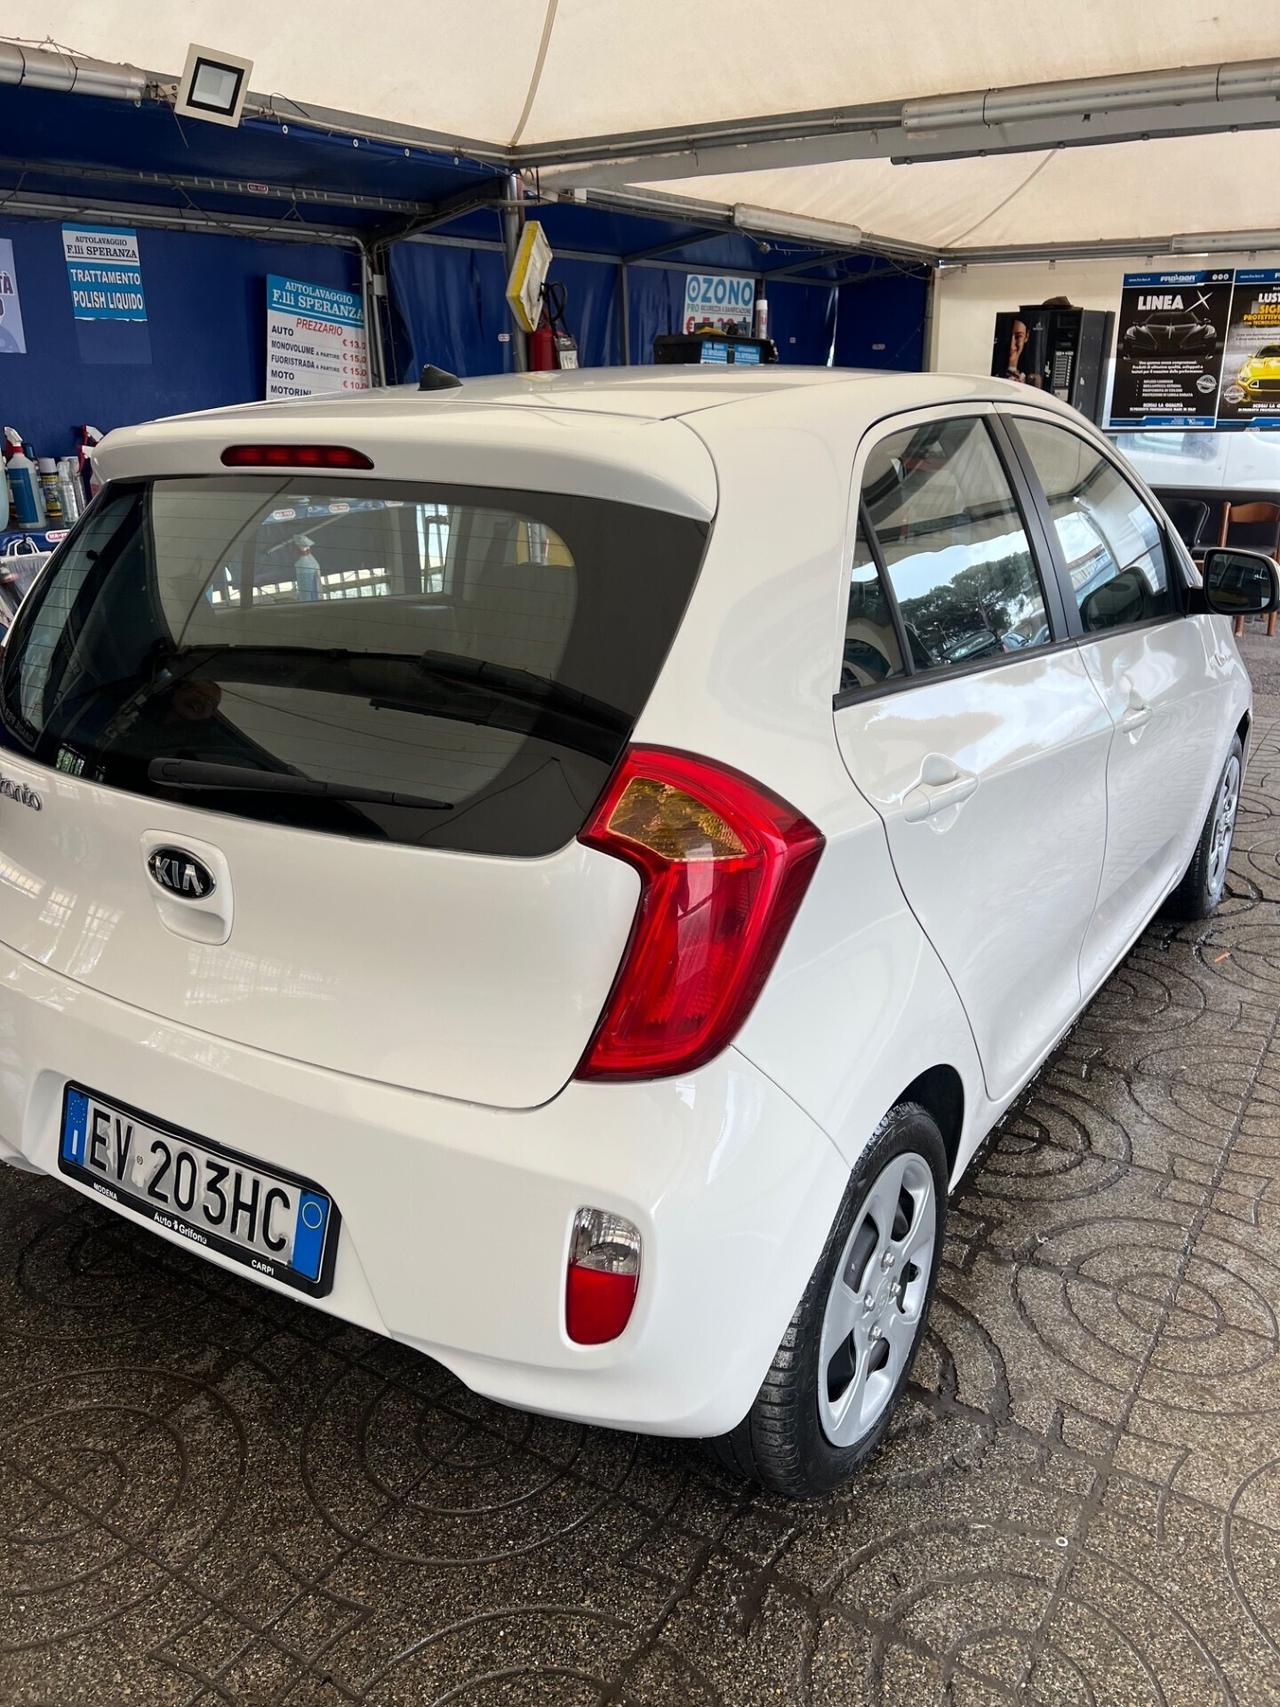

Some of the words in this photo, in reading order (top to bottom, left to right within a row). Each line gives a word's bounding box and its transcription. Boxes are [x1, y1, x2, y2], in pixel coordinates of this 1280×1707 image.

[75, 236, 127, 246] AUTOLAVAGGIO
[66, 244, 84, 255] F.lli
[86, 246, 138, 259] SPERANZA
[70, 269, 140, 285] TRATTAMENTO
[73, 290, 107, 308] POLISH
[107, 291, 144, 310] LIQUIDO
[285, 281, 353, 304] AUTOLAVAGGIO
[687, 276, 753, 306] OZONO
[1137, 294, 1184, 311] LINEA
[1184, 290, 1213, 312] X
[272, 289, 295, 305] F.lli
[298, 295, 365, 320] SPERANZA
[686, 303, 699, 312] PRO
[271, 325, 294, 337] AUTO
[343, 339, 347, 347] €
[296, 318, 343, 336] PREZZARIO
[271, 340, 315, 355] MONOVOLUME
[343, 353, 347, 361] €
[271, 354, 315, 369] FUORISTRADA
[343, 366, 348, 374] €
[271, 369, 295, 381] MOTO
[343, 380, 348, 388] €
[155, 855, 204, 896] KIA
[90, 1107, 133, 1181] EV
[147, 1140, 291, 1252] 203HC
[93, 1181, 118, 1201] MODENA
[153, 1212, 172, 1229] Auto
[251, 1259, 275, 1276] CARPI
